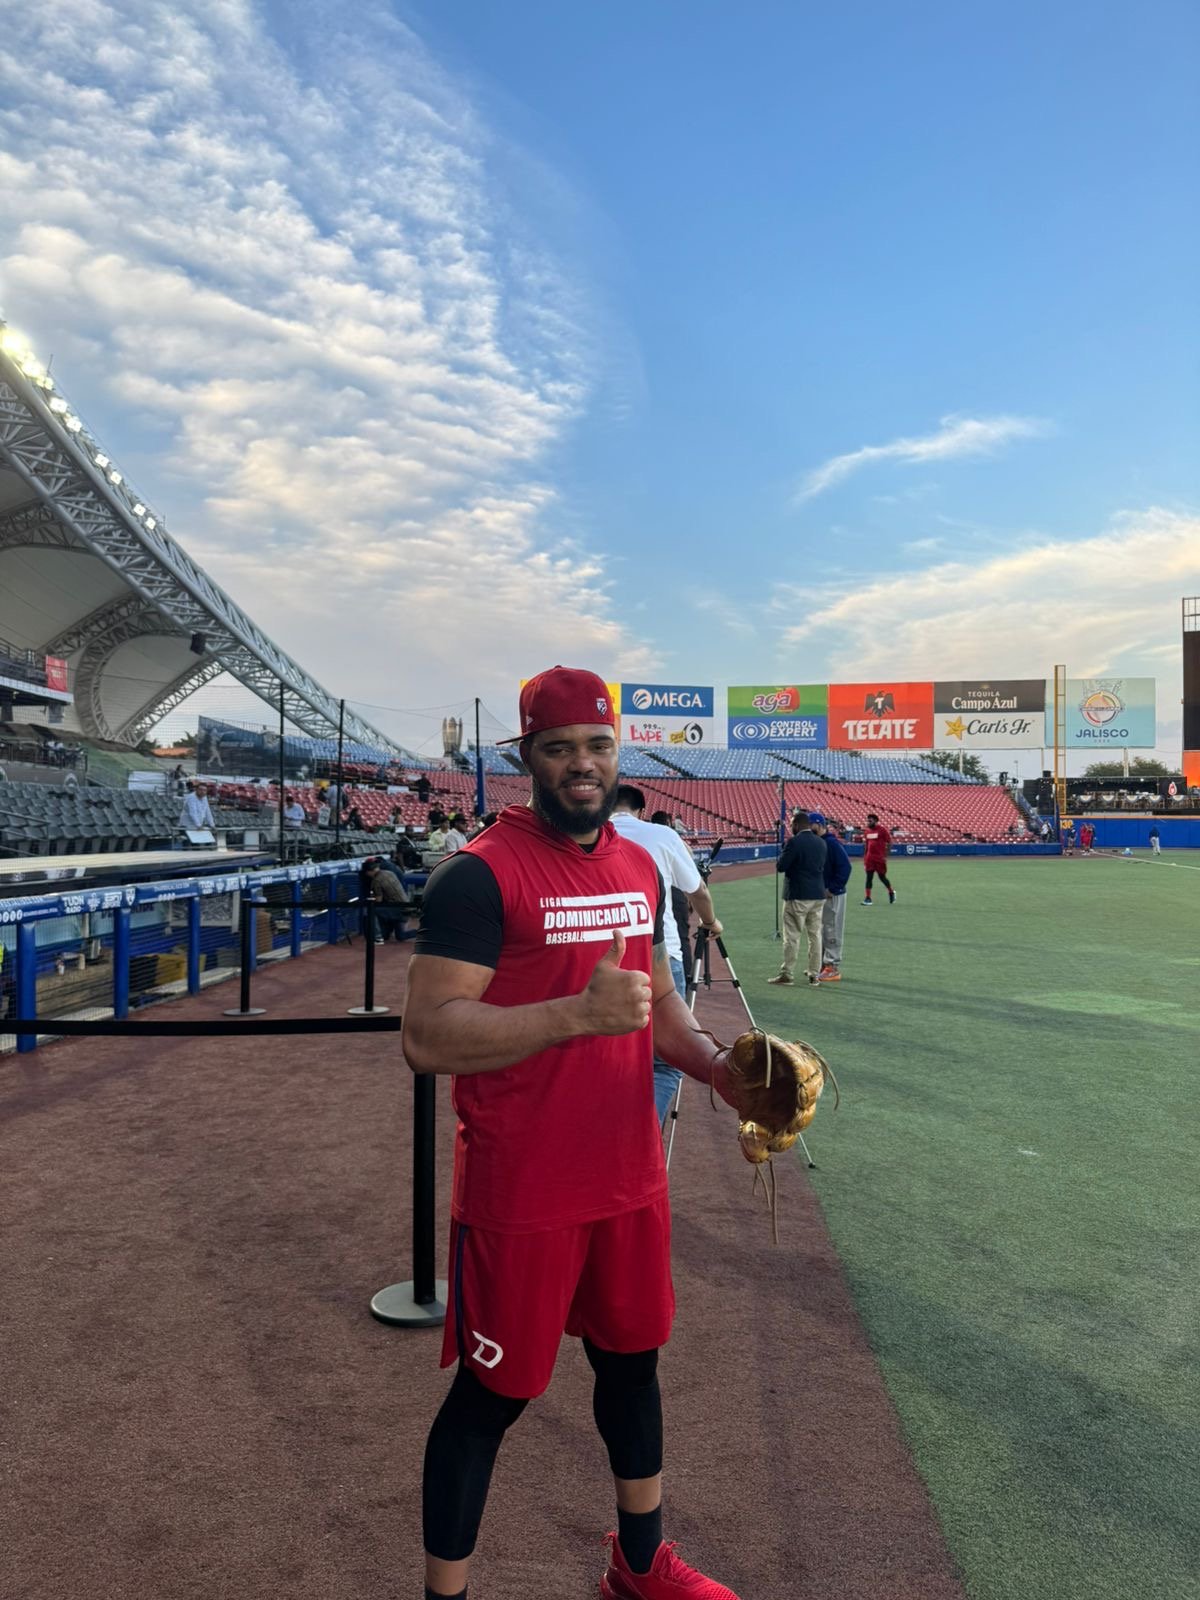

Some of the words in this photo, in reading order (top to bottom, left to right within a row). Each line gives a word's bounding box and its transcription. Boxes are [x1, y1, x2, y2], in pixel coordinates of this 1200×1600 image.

[653, 692, 703, 708] MEGA
[752, 694, 791, 714] aga
[951, 697, 990, 711] Campo
[992, 696, 1018, 709] Azul
[770, 720, 812, 728] CONTROL
[842, 719, 919, 740] TECATE
[967, 719, 1008, 735] Carl's
[1010, 719, 1031, 735] Jr.
[684, 722, 703, 745] 6
[769, 728, 816, 737] EXPERT
[1076, 729, 1129, 738] JALISCO
[540, 897, 562, 908] LIGA
[544, 906, 629, 929] DOMINICANA
[545, 931, 585, 945] BASEBALL
